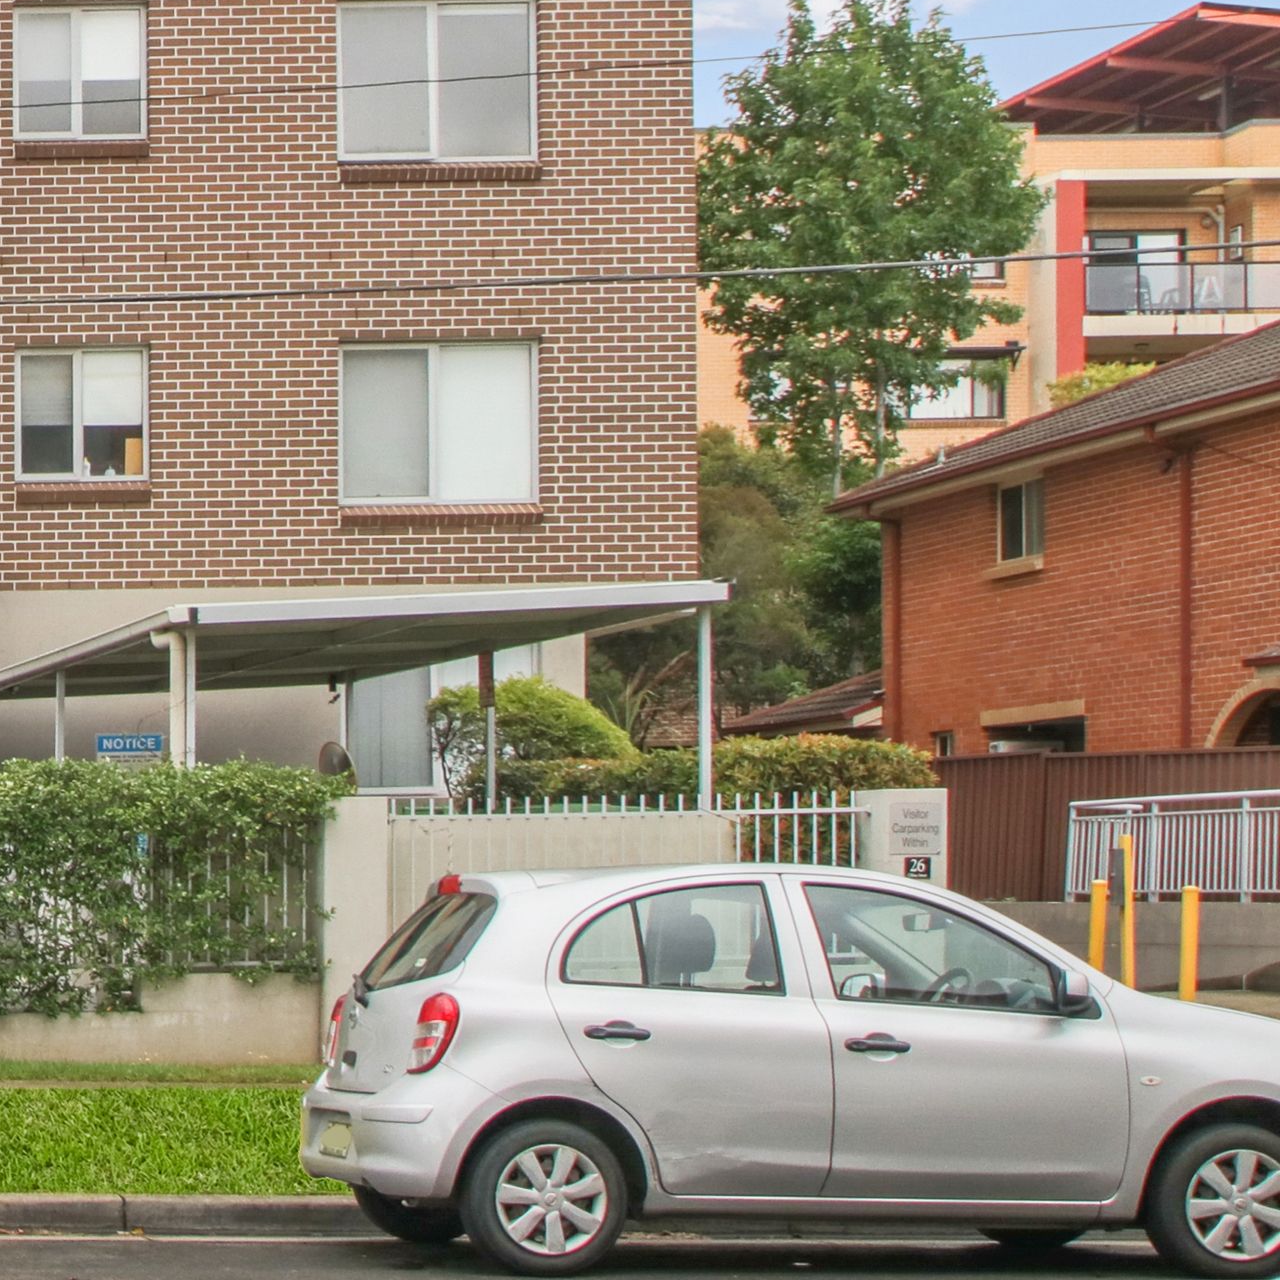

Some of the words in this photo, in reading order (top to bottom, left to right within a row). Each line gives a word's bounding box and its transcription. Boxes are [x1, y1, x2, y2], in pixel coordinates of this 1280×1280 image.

[102, 738, 156, 749] NOTICE
[902, 808, 929, 819] Visitor
[891, 823, 940, 835] Carparking
[902, 837, 928, 848] Within
[909, 858, 926, 873] 26
